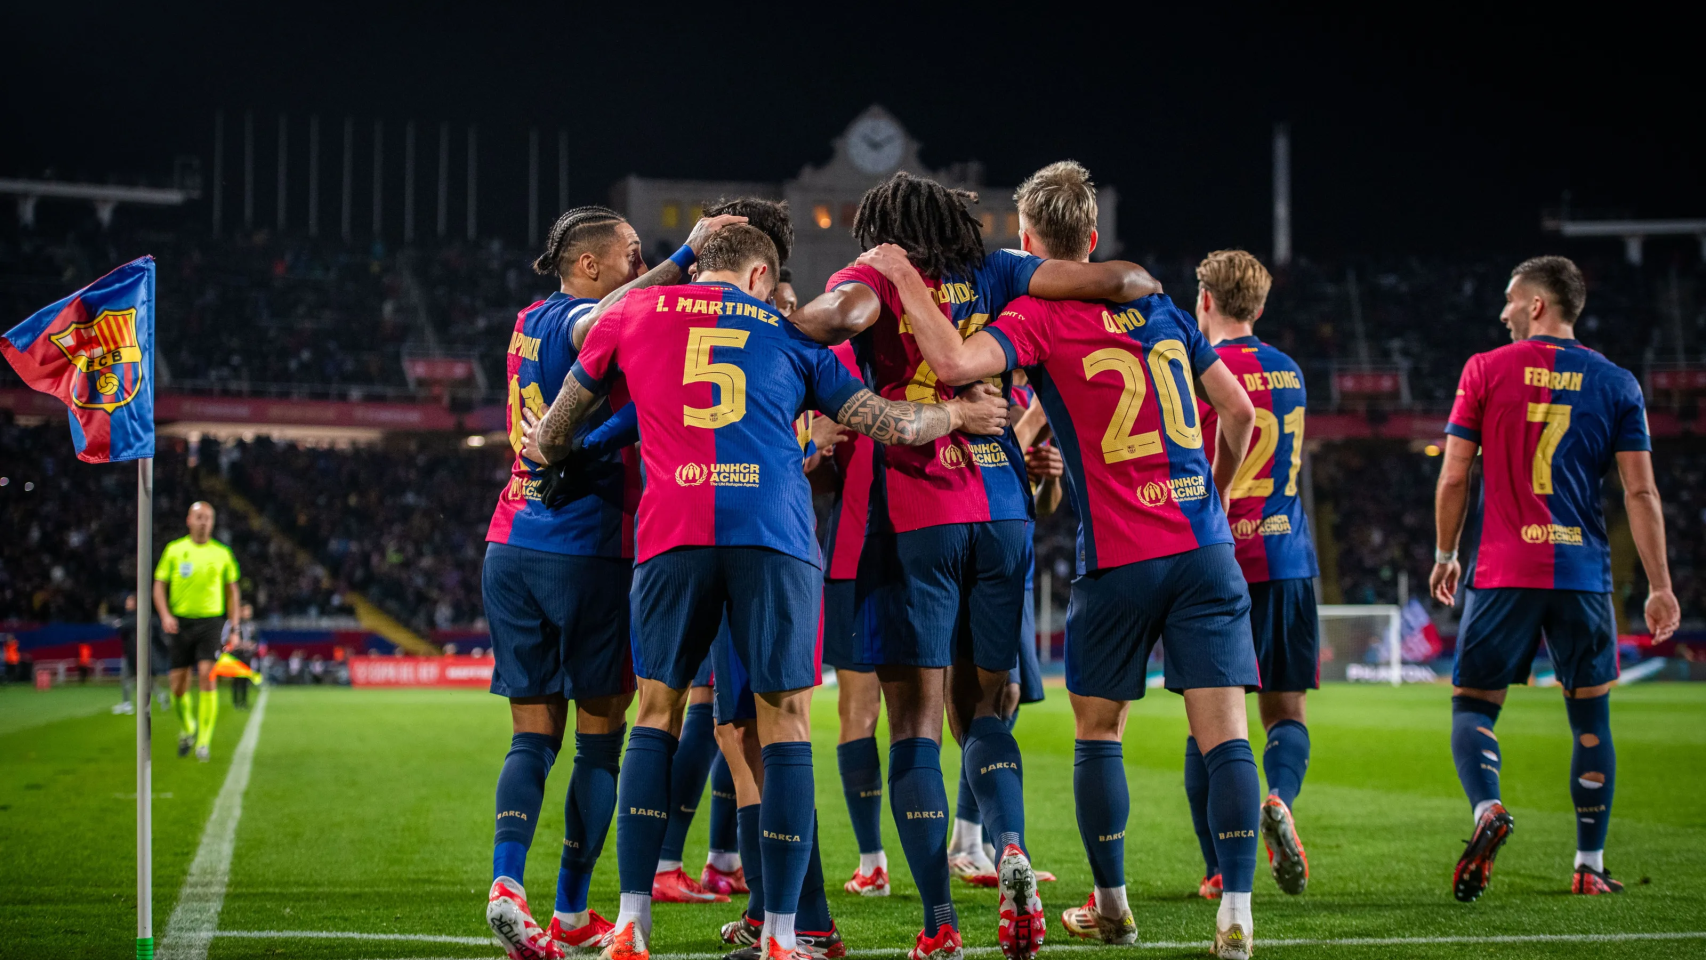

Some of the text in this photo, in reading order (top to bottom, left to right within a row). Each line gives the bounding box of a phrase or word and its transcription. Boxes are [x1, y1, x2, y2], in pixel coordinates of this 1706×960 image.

[656, 295, 779, 327] I. MARTINEZ
[86, 350, 123, 371] FCB
[683, 327, 750, 429] 5
[1243, 372, 1265, 392] DE
[1262, 371, 1301, 390] JONG
[1524, 366, 1583, 391] FERRAN
[1082, 339, 1203, 464] 20
[1230, 406, 1305, 499] 21
[1526, 402, 1572, 495] 7
[710, 463, 760, 474] UNHCR
[709, 472, 760, 483] ACNUR
[1166, 475, 1205, 490] UNHCR
[1171, 485, 1208, 499] ACNUR
[980, 761, 1018, 775] BARÇA
[497, 810, 528, 821] BARÇA
[630, 806, 668, 820] BARÇA
[906, 810, 945, 820] BARÇA
[763, 829, 801, 842] BARÇA
[1218, 829, 1255, 840] BARÇA
